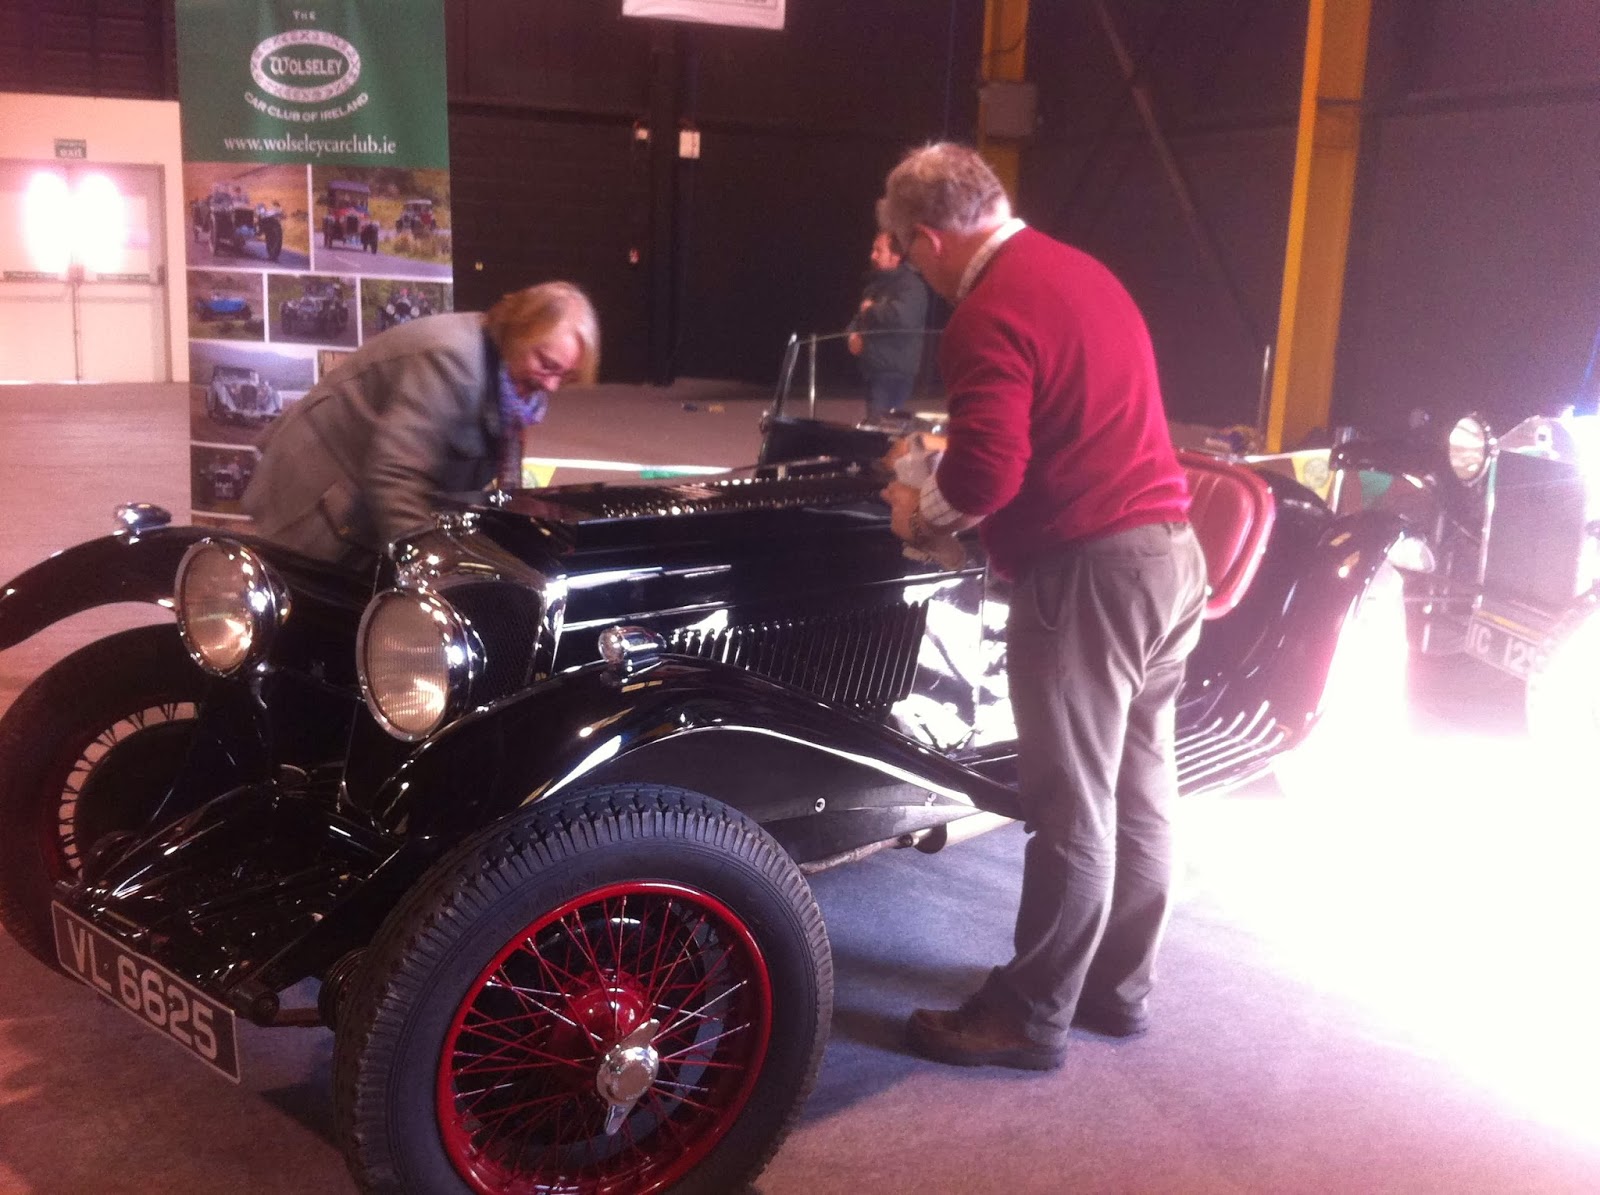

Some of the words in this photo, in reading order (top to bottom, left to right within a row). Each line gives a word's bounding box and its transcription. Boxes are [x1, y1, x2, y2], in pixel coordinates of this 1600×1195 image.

[292, 10, 316, 21] THE
[269, 56, 344, 76] WOLSELEY
[244, 91, 268, 113] CAR
[267, 105, 301, 122] CLUB
[301, 111, 318, 122] OF
[320, 91, 369, 121] IRELAND
[223, 133, 397, 157] www.wolseleycarclub.ie
[66, 918, 112, 994] VL
[117, 954, 218, 1060] 6625
